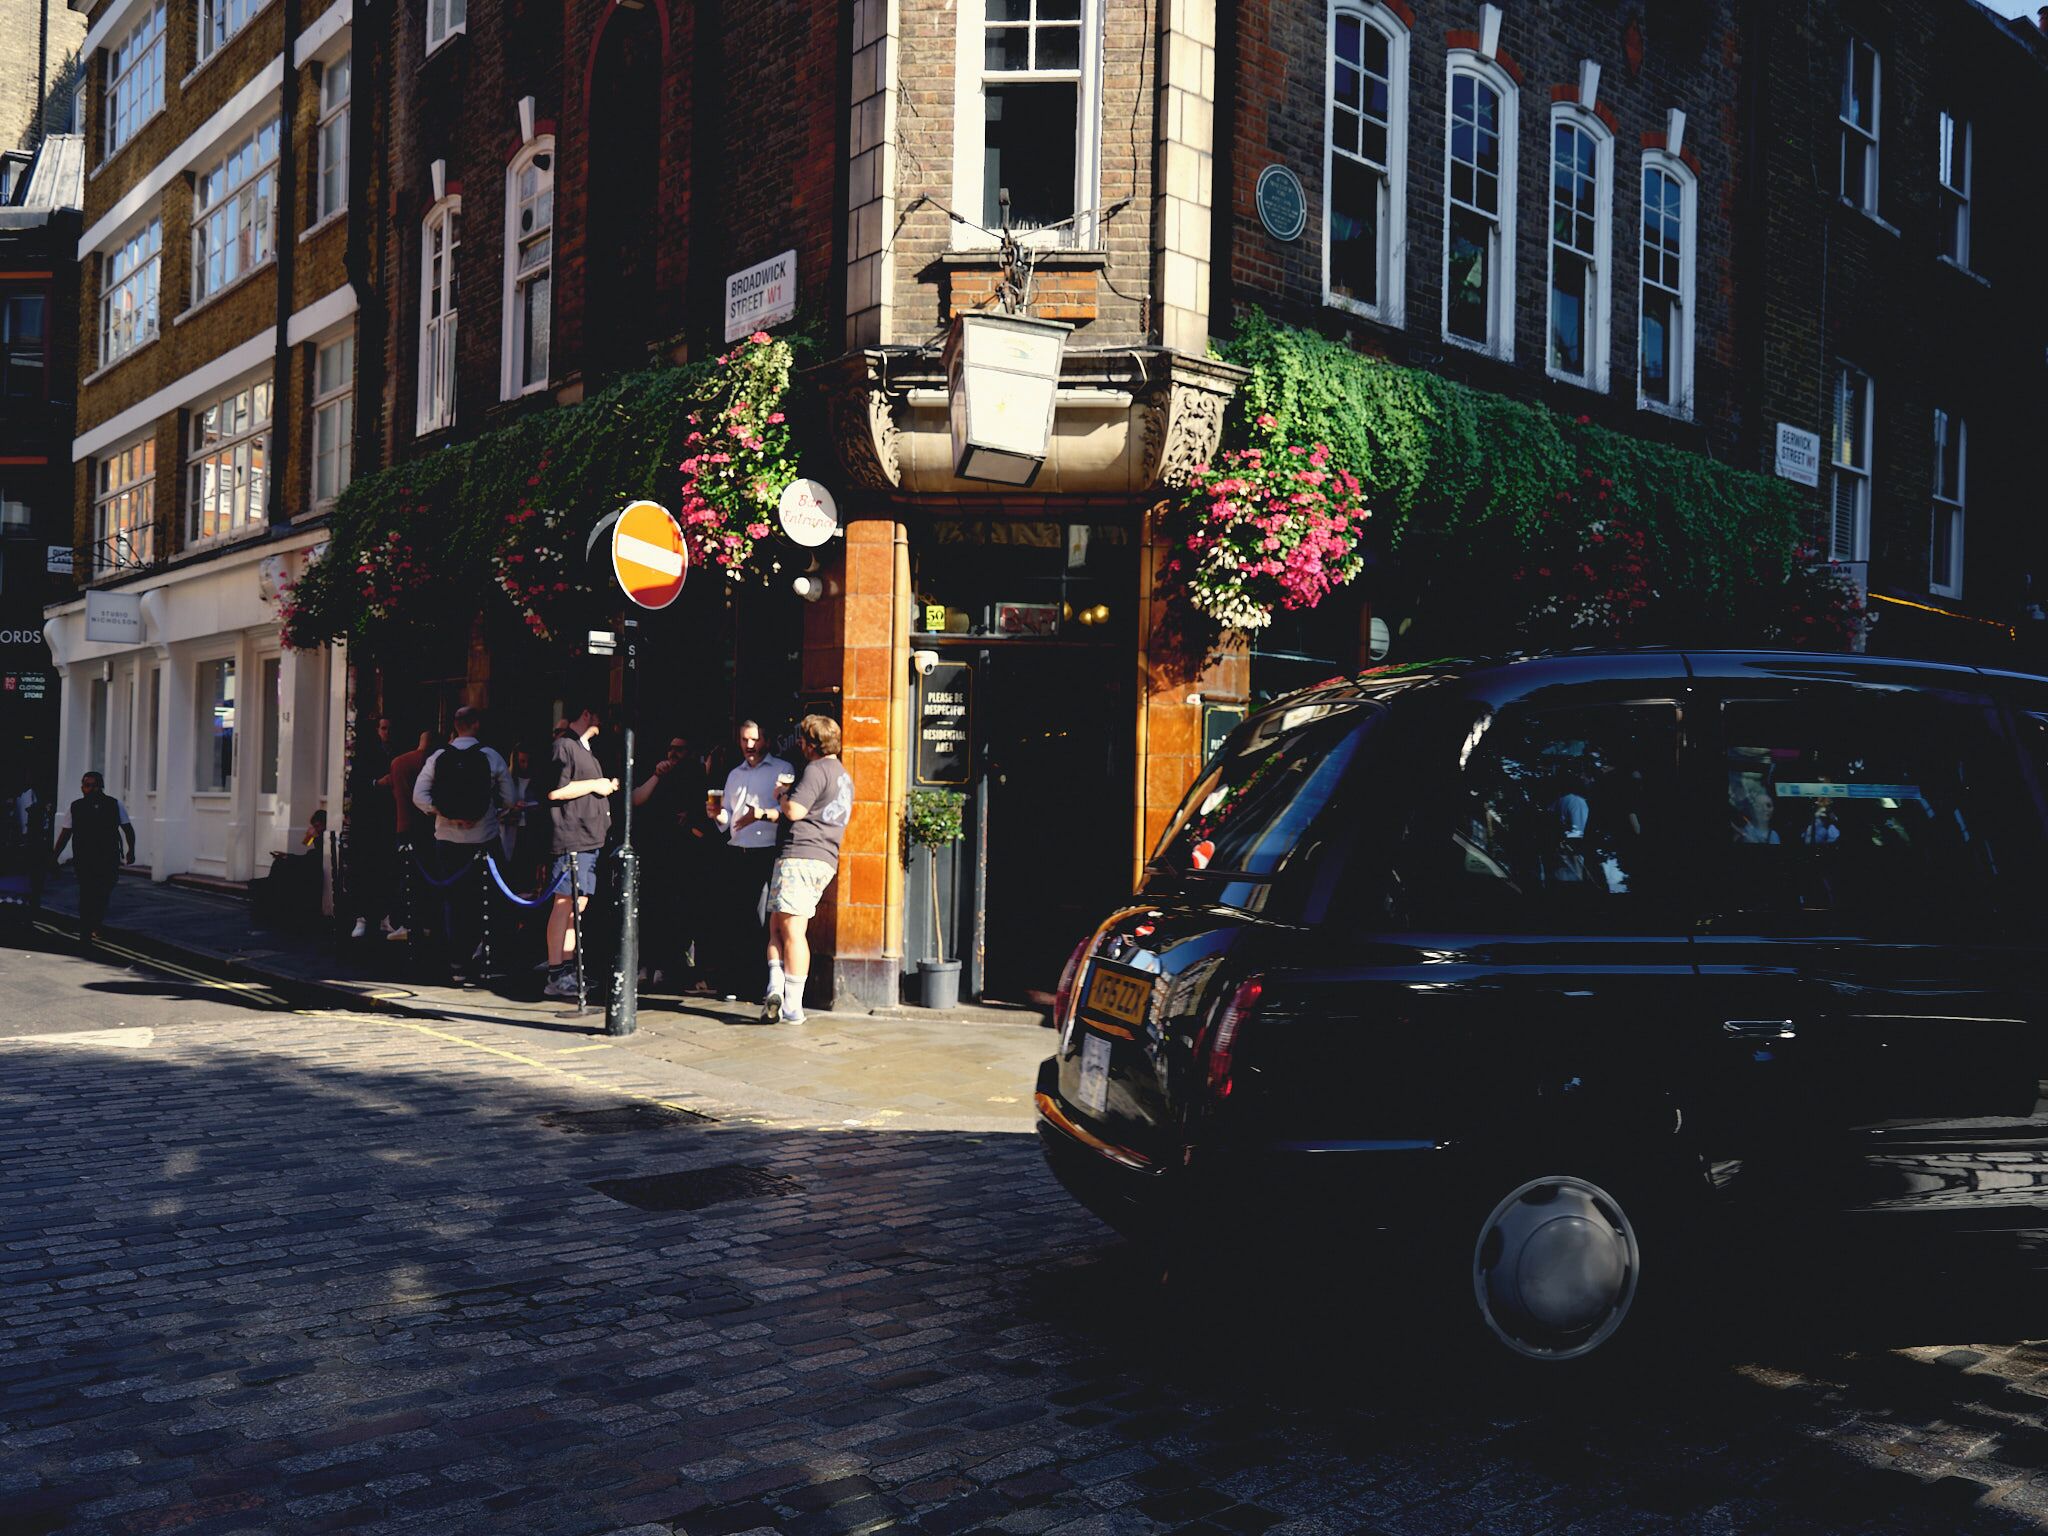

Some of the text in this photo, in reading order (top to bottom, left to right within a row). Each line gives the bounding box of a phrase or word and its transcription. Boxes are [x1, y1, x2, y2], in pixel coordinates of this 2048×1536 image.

[731, 261, 787, 298] BROADWICK
[730, 284, 782, 318] STREET W1
[1782, 429, 1812, 452] BERWICK
[1782, 446, 1816, 468] STREET W1
[101, 610, 128, 618] STUDIO
[91, 617, 138, 625] NICHOLSON
[0, 629, 41, 644] ORDS
[628, 644, 636, 670] S 4
[24, 691, 43, 699] STORE
[927, 692, 964, 704] PLEASE BE
[924, 704, 966, 716] RESPECTFUL
[923, 729, 966, 741] RESIDENTIAL
[935, 741, 954, 753] AREA
[1118, 981, 1144, 1015] ZZX
